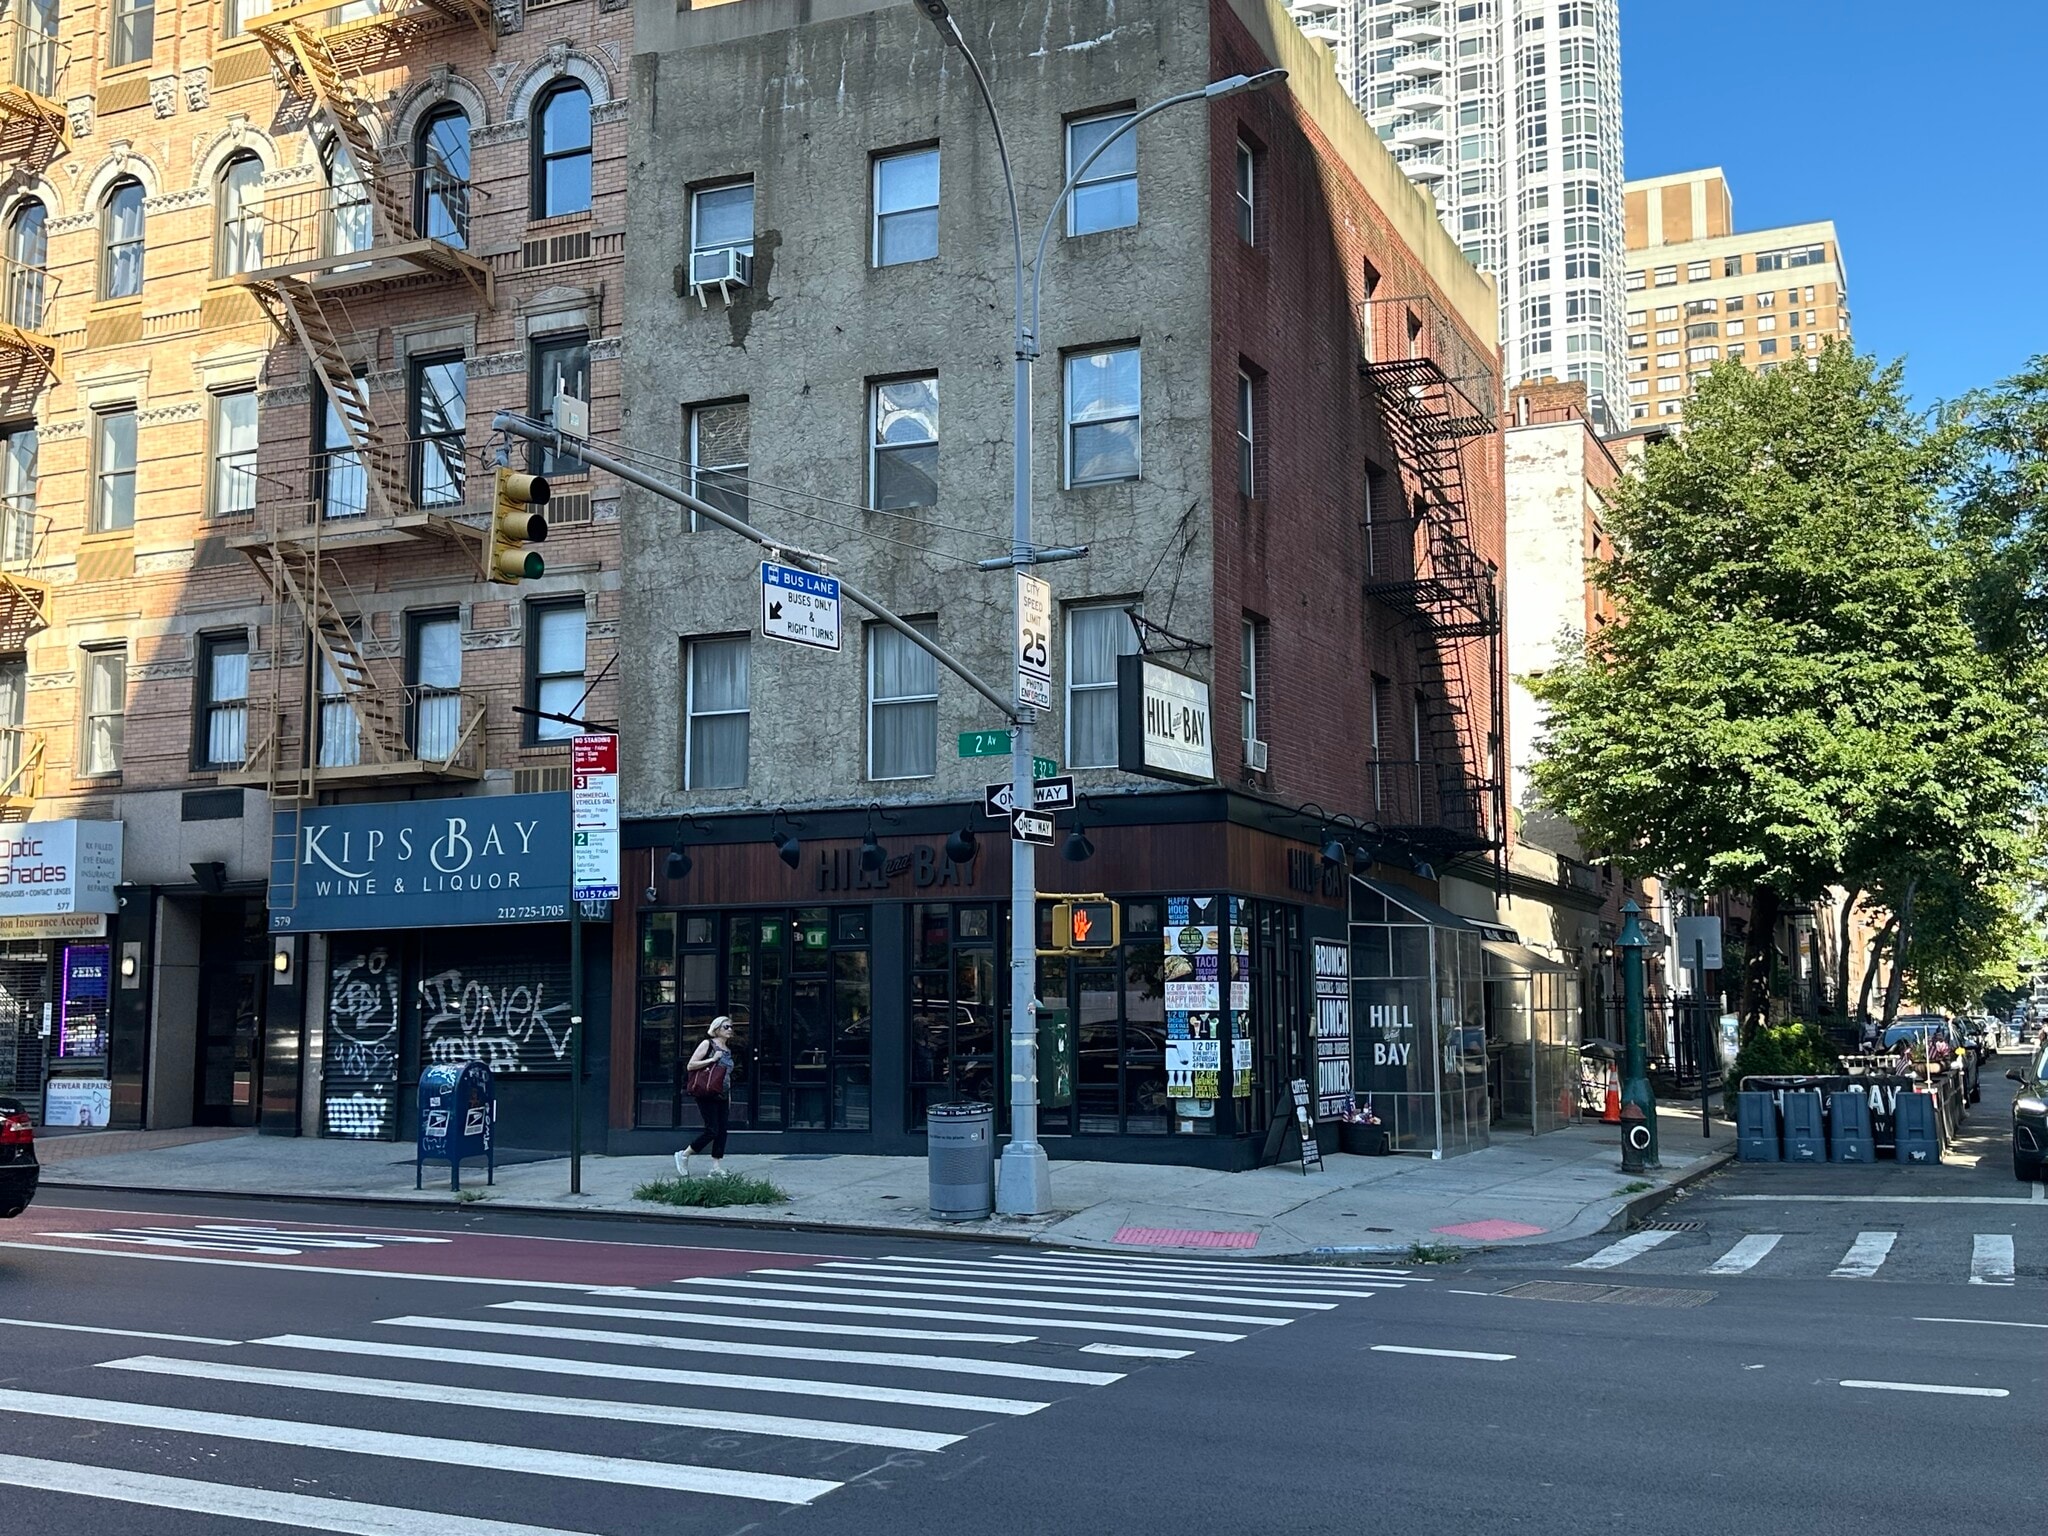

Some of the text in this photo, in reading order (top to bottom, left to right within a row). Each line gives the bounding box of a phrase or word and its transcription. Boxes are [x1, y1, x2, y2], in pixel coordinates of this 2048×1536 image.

[783, 572, 834, 595] BUS LANE
[1026, 582, 1040, 596] CITY
[788, 592, 832, 612] BUSES ONLY
[1023, 597, 1043, 613] SPEED
[808, 611, 815, 623] &
[1025, 612, 1041, 627] LIMIT
[787, 622, 834, 641] RIGHT TURNS
[1022, 628, 1047, 668] 25
[1026, 678, 1043, 692] PHOTO
[1021, 687, 1048, 704] ENFORCED
[1146, 695, 1176, 740] HILL
[1182, 706, 1205, 748] BAY
[584, 736, 611, 744] STANDING
[975, 735, 983, 753] 2
[1039, 761, 1047, 779] 32
[576, 776, 585, 789] 3
[1000, 787, 1062, 805] ON WAY
[1018, 819, 1050, 836] ONE WAY
[577, 833, 585, 845] 2
[94, 843, 113, 851] FILLED
[302, 817, 539, 878] KIPS BAY
[0, 862, 67, 885] Shades
[81, 871, 115, 879] INSURANCE
[815, 848, 890, 891] HILL
[87, 885, 109, 893] REPAIRS
[316, 872, 521, 896] WINE & LIQUOR
[29, 889, 52, 897] CONTACT
[54, 887, 71, 895] LENSES
[575, 889, 607, 899] 101576
[57, 902, 70, 911] 577
[1168, 897, 1189, 905] HAPPY
[498, 904, 565, 918] 212 725-1705
[1168, 905, 1189, 914] HOUR
[16, 915, 58, 928] Insurance
[60, 915, 99, 928] Accepted
[274, 916, 291, 927] 579
[1195, 956, 1218, 968] TACO
[1315, 945, 1347, 976] BRUNCH
[1317, 999, 1349, 1037] LUNCH
[1369, 1004, 1413, 1028] HILL
[1192, 1042, 1218, 1051] 1/2 OFF
[1373, 1042, 1411, 1066] BAY
[1195, 1071, 1205, 1079] 1/2
[1318, 1060, 1350, 1095] DINNER
[49, 1082, 111, 1090] EYEWEAR REPAIRS
